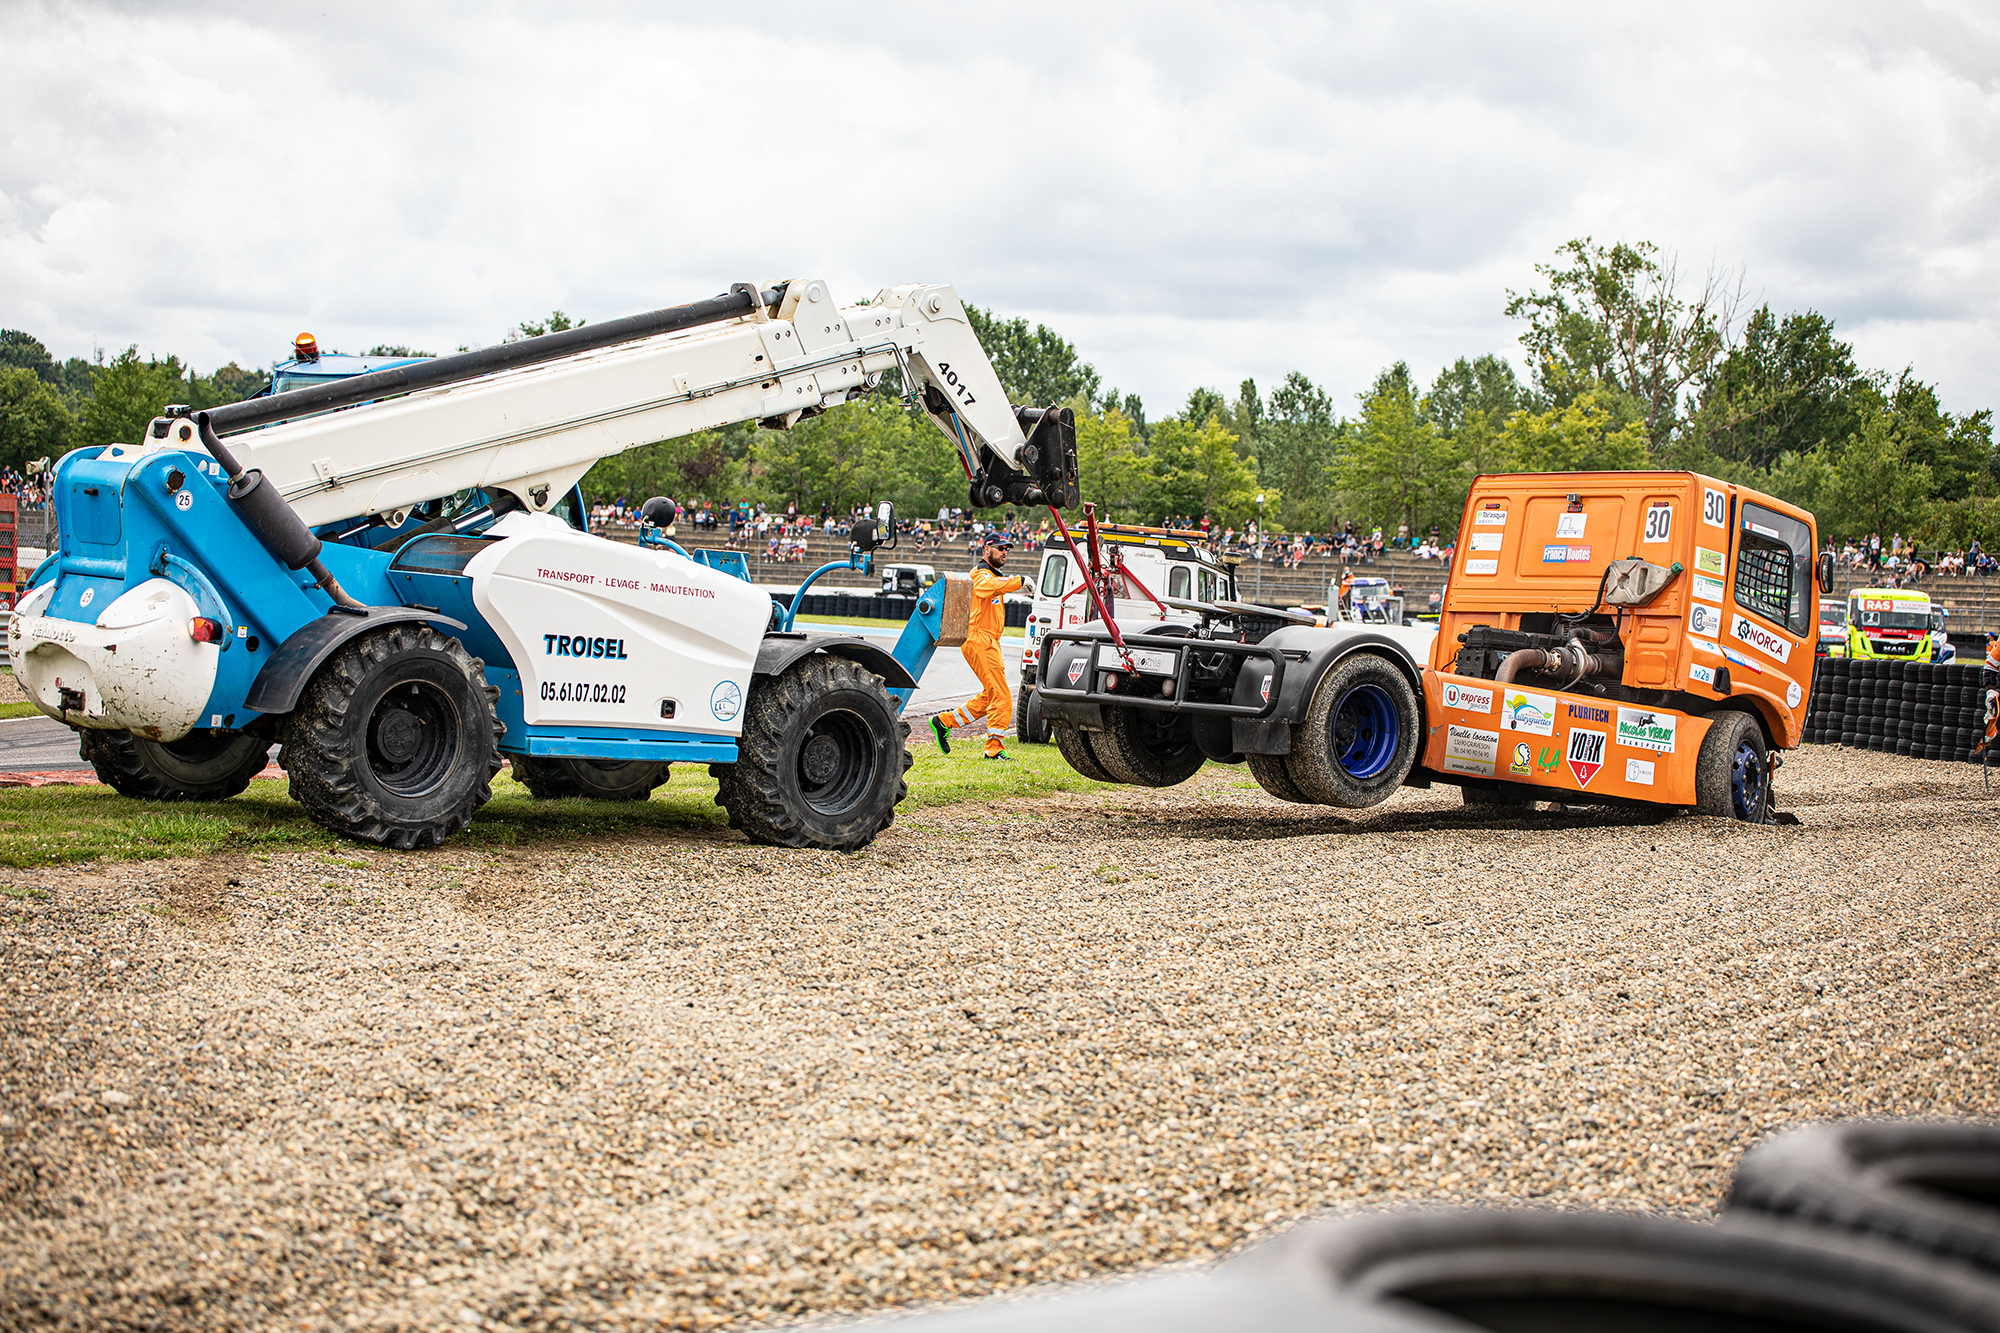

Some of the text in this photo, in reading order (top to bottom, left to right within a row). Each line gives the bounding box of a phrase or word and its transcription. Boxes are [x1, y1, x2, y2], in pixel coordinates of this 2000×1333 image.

[938, 362, 976, 406] 4017
[179, 494, 190, 506] 25
[1705, 491, 1724, 524] 30
[1645, 509, 1671, 539] 30
[1543, 547, 1591, 561] France Routes
[537, 568, 595, 585] TRANSPORT
[605, 577, 640, 590] LEVAGE
[650, 583, 716, 599] MANUTENTION
[1866, 600, 1891, 610] RAS
[543, 633, 628, 660] TROISEL
[1749, 628, 1783, 657] NORCA
[1883, 645, 1906, 653] MAN
[1694, 669, 1710, 682] M2B
[540, 681, 627, 704] 05.61.07.02.02
[1448, 690, 1490, 705] U express
[1568, 704, 1610, 723] PLURITECH
[1449, 726, 1498, 743] Vinelle location
[1569, 732, 1605, 762] YORK
[1617, 738, 1672, 752] TRANSPORTS
